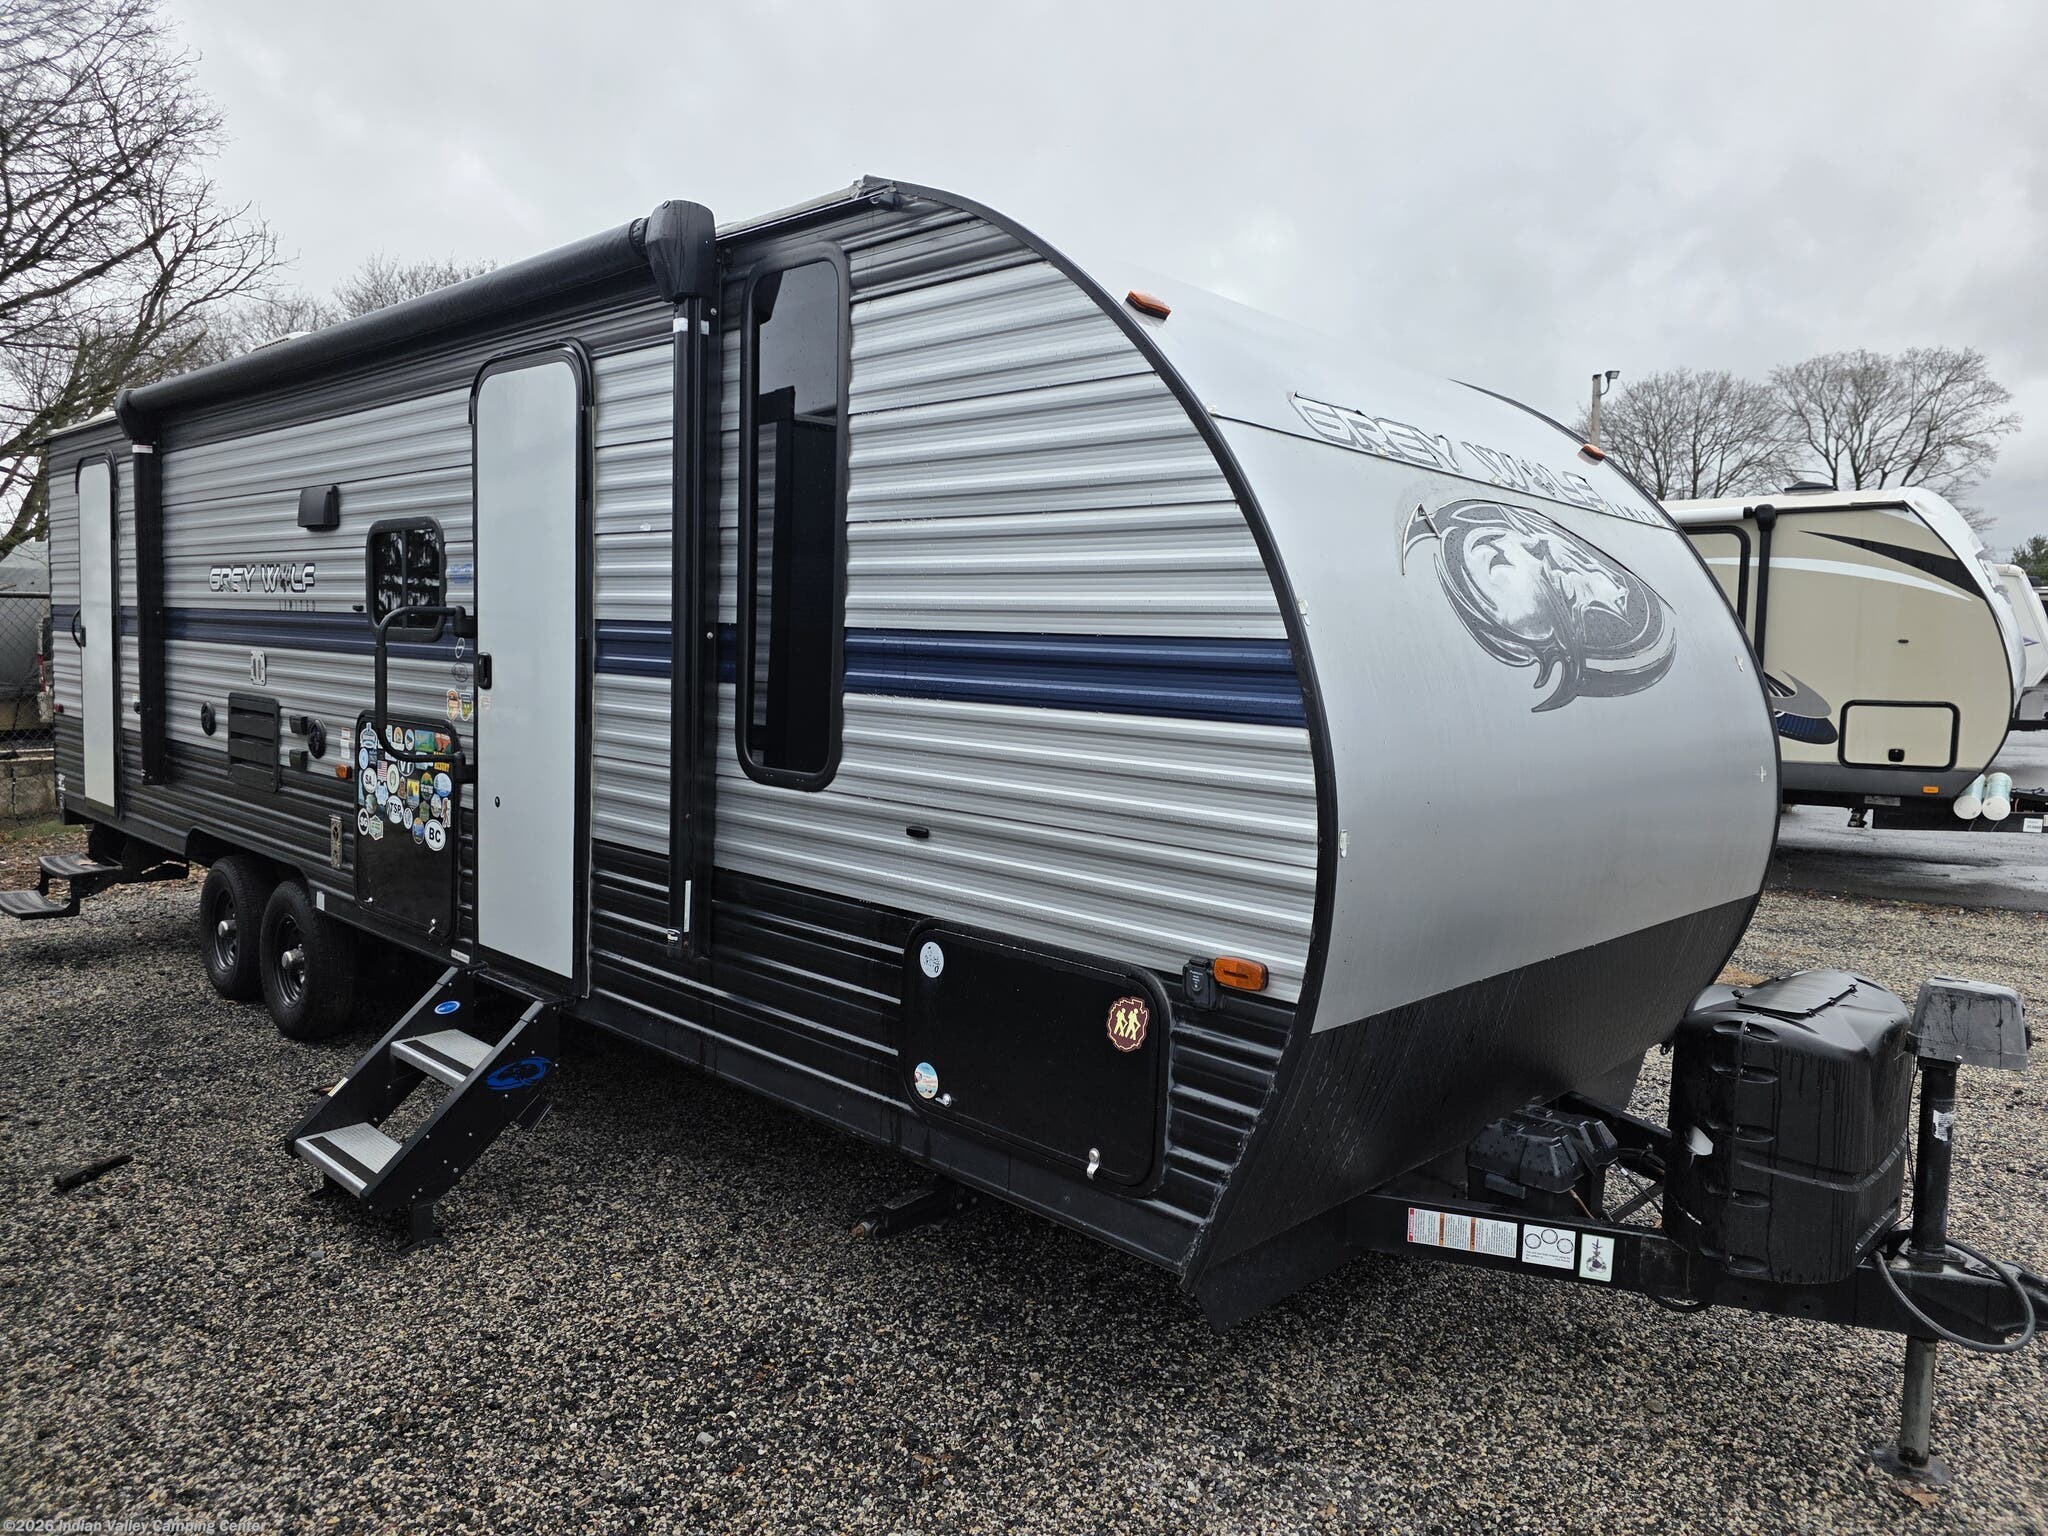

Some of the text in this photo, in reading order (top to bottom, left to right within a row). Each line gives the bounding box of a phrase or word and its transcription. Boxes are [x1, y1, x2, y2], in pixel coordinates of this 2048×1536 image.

[1289, 391, 1462, 473] GREY
[209, 565, 256, 592] GREY
[429, 827, 441, 843] BC
